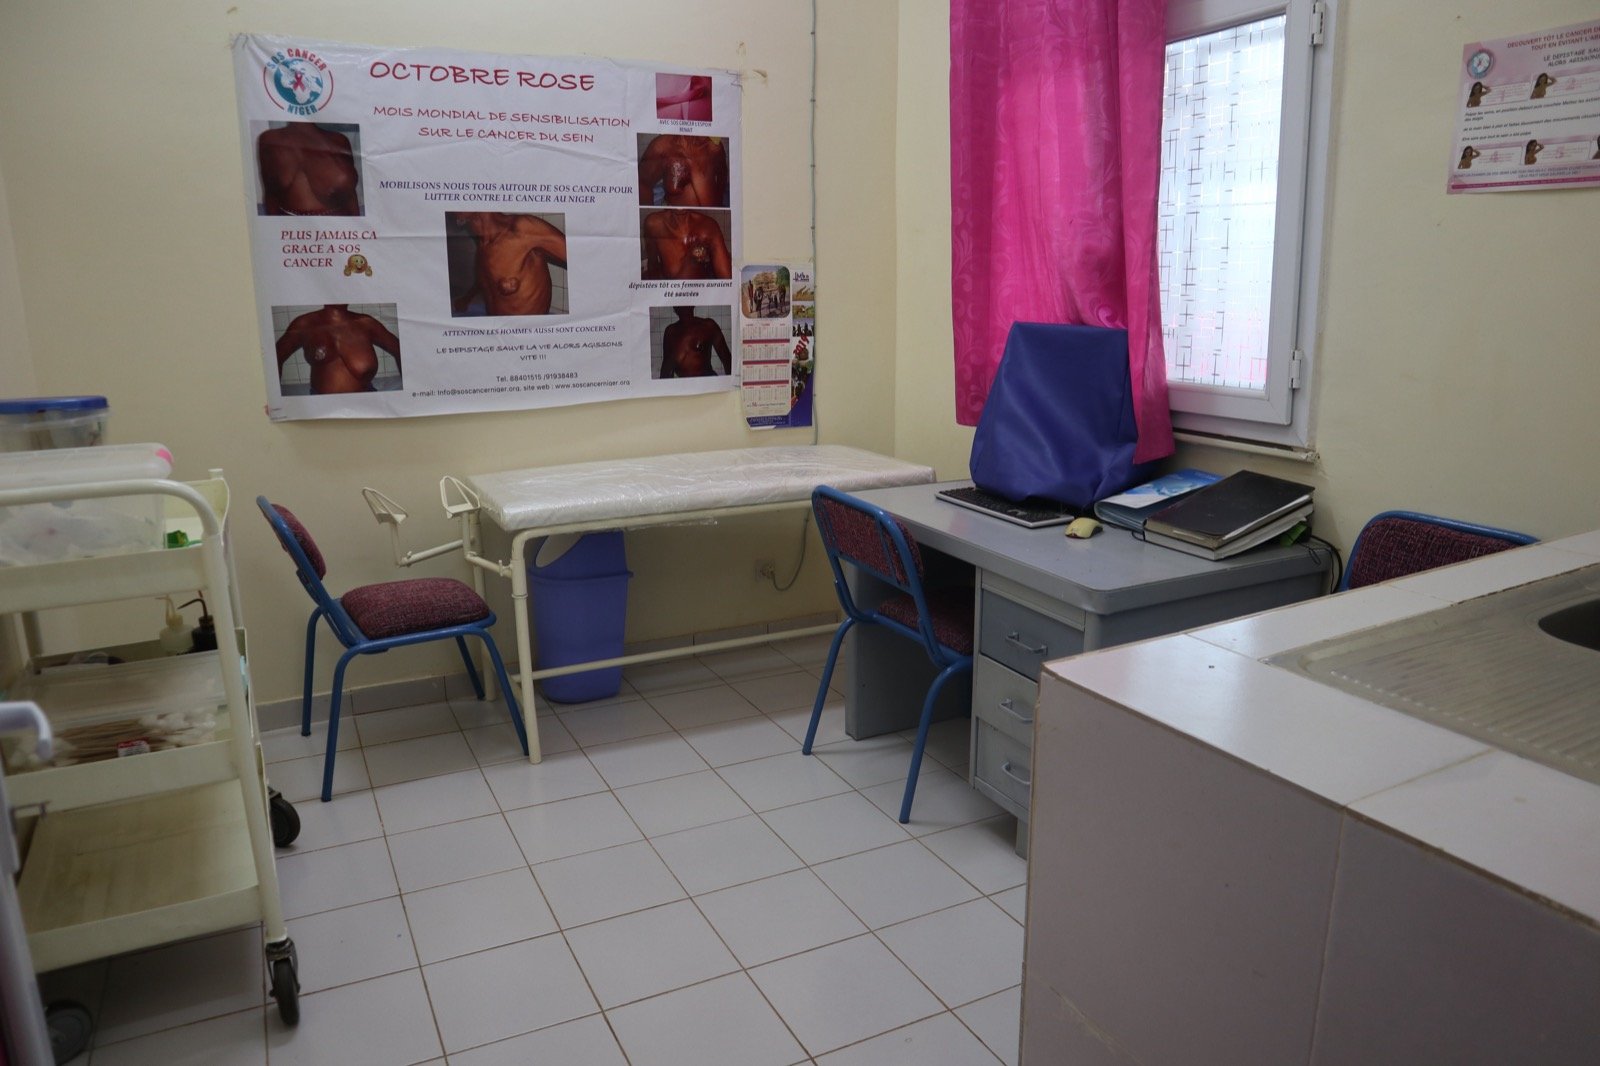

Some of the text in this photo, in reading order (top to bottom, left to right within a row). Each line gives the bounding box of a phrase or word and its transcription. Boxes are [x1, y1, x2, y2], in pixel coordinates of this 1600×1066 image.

[266, 48, 326, 71] SOS CANCER
[370, 62, 594, 91] OCTOBRE ROSE
[288, 104, 318, 116] NIGER
[374, 106, 630, 128] MOIS MONDIAL DE SENSIBILISATION
[418, 127, 594, 143] SUR LE CANCER DU SEIN
[380, 180, 633, 194] MOBILISONS NOUS TOUS AUTOUR DE SOS CANCER POUR
[424, 192, 596, 204] LUTTER CONTRE LE CANCER AU NIGER
[281, 230, 378, 242] PLUS JAMAIS CA
[282, 244, 361, 254] GRACE A SOS
[283, 258, 333, 268] CANCER
[681, 281, 705, 290] femmes
[442, 329, 486, 337] ATTENTION
[448, 346, 494, 354] DEPISTAGE
[582, 341, 623, 350] AGISSONS
